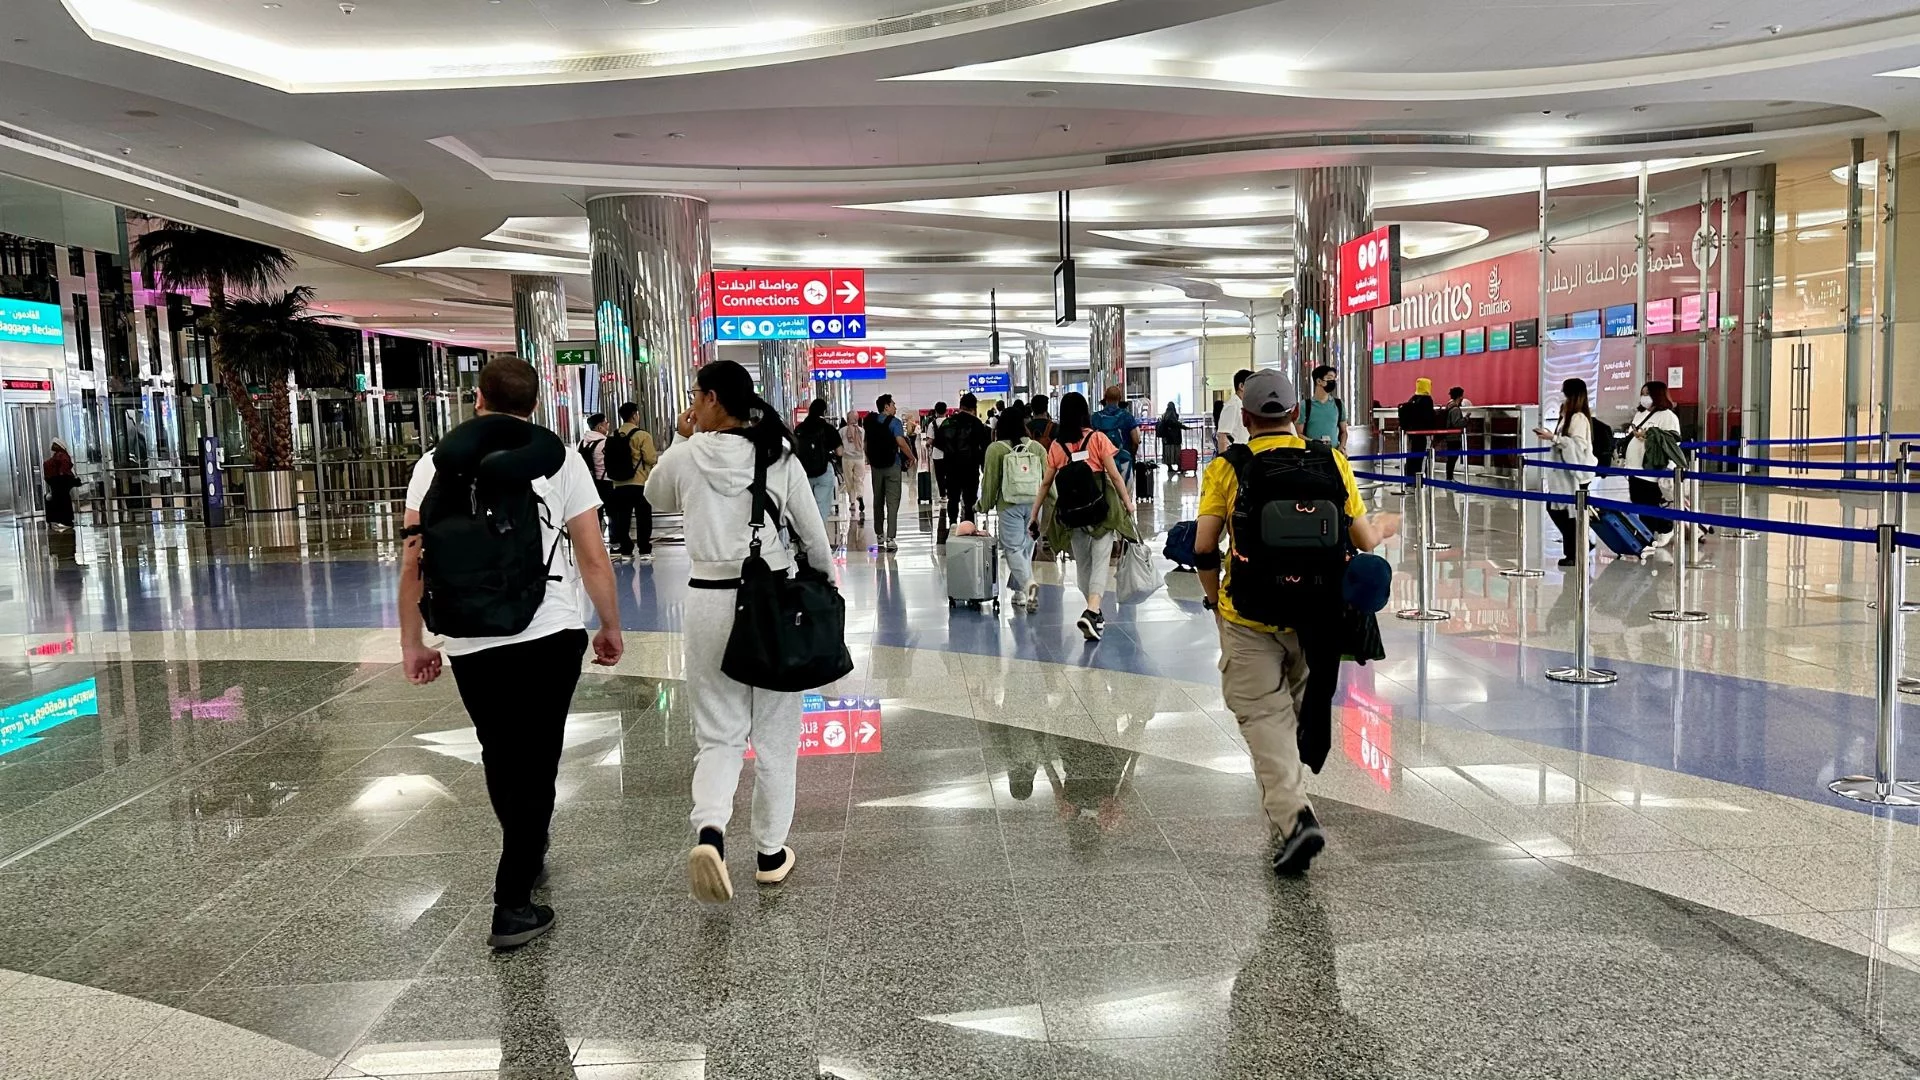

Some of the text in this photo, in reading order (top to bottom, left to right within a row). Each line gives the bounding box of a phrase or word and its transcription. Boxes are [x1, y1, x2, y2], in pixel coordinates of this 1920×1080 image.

[1585, 256, 1638, 285] مواصلة
[717, 279, 799, 292] مواصلة الرحلات
[722, 294, 800, 307] Connections
[1479, 300, 1511, 317] Emirates
[1607, 317, 1626, 326] UNITED
[32, 323, 62, 337] Reclaim
[777, 328, 808, 336] Arrivals
